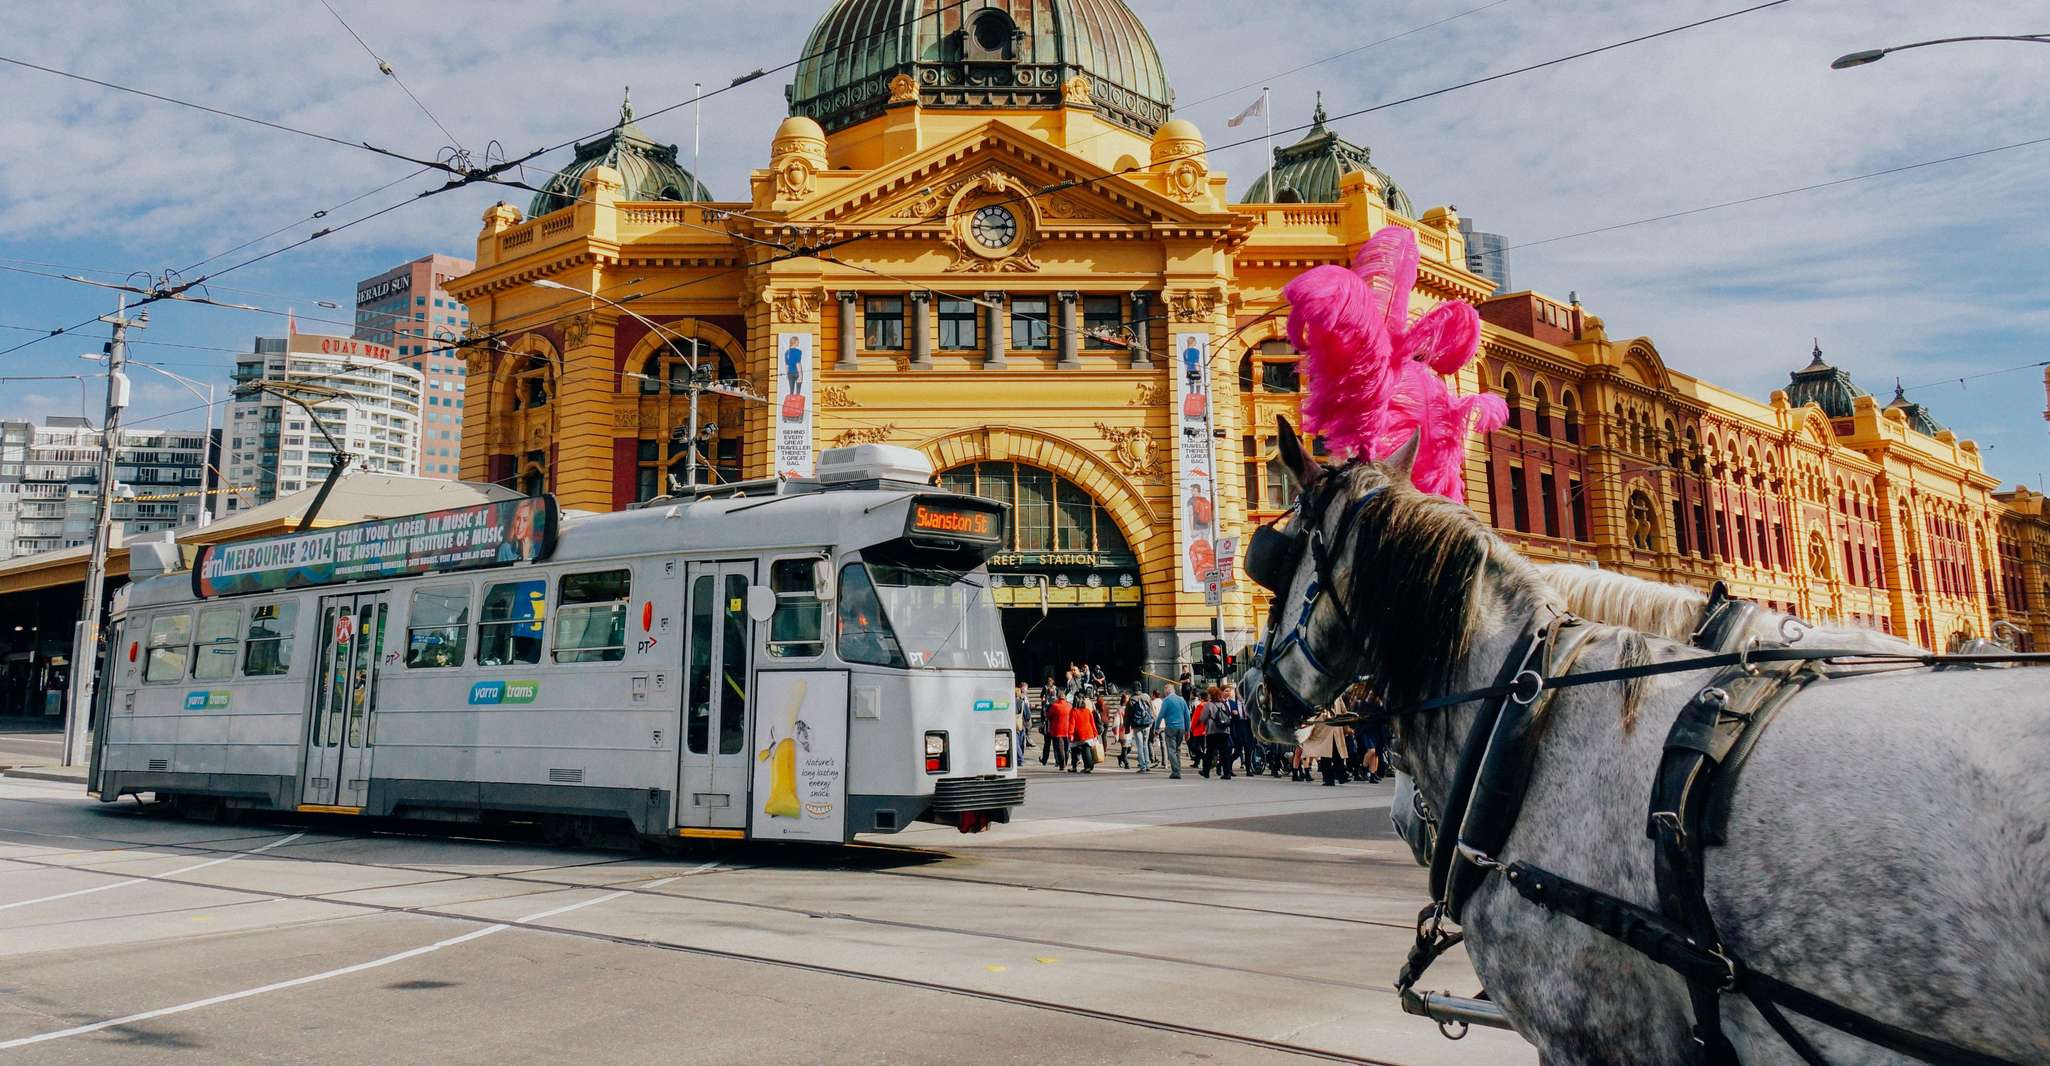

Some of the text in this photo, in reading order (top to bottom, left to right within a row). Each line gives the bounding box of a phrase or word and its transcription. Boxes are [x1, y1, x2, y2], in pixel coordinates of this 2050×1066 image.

[391, 274, 410, 292] SUN
[322, 339, 391, 360] QUAY WEST
[338, 509, 489, 545] START YOUR CAREER IN MUSIC AT
[916, 506, 988, 533] Swanston St
[336, 525, 504, 562] THE AUSTRALIAN INSTITUTE OF MUSIC
[202, 537, 334, 579] aim MELBOURNE 2014
[1039, 554, 1096, 566] STATION
[984, 650, 1005, 668] 167
[186, 693, 228, 709] yarra trams
[474, 683, 533, 702] yarra trams
[806, 757, 835, 767] Nature's
[801, 768, 839, 780] long lasting
[808, 780, 831, 791] energy
[810, 790, 830, 798] snack
